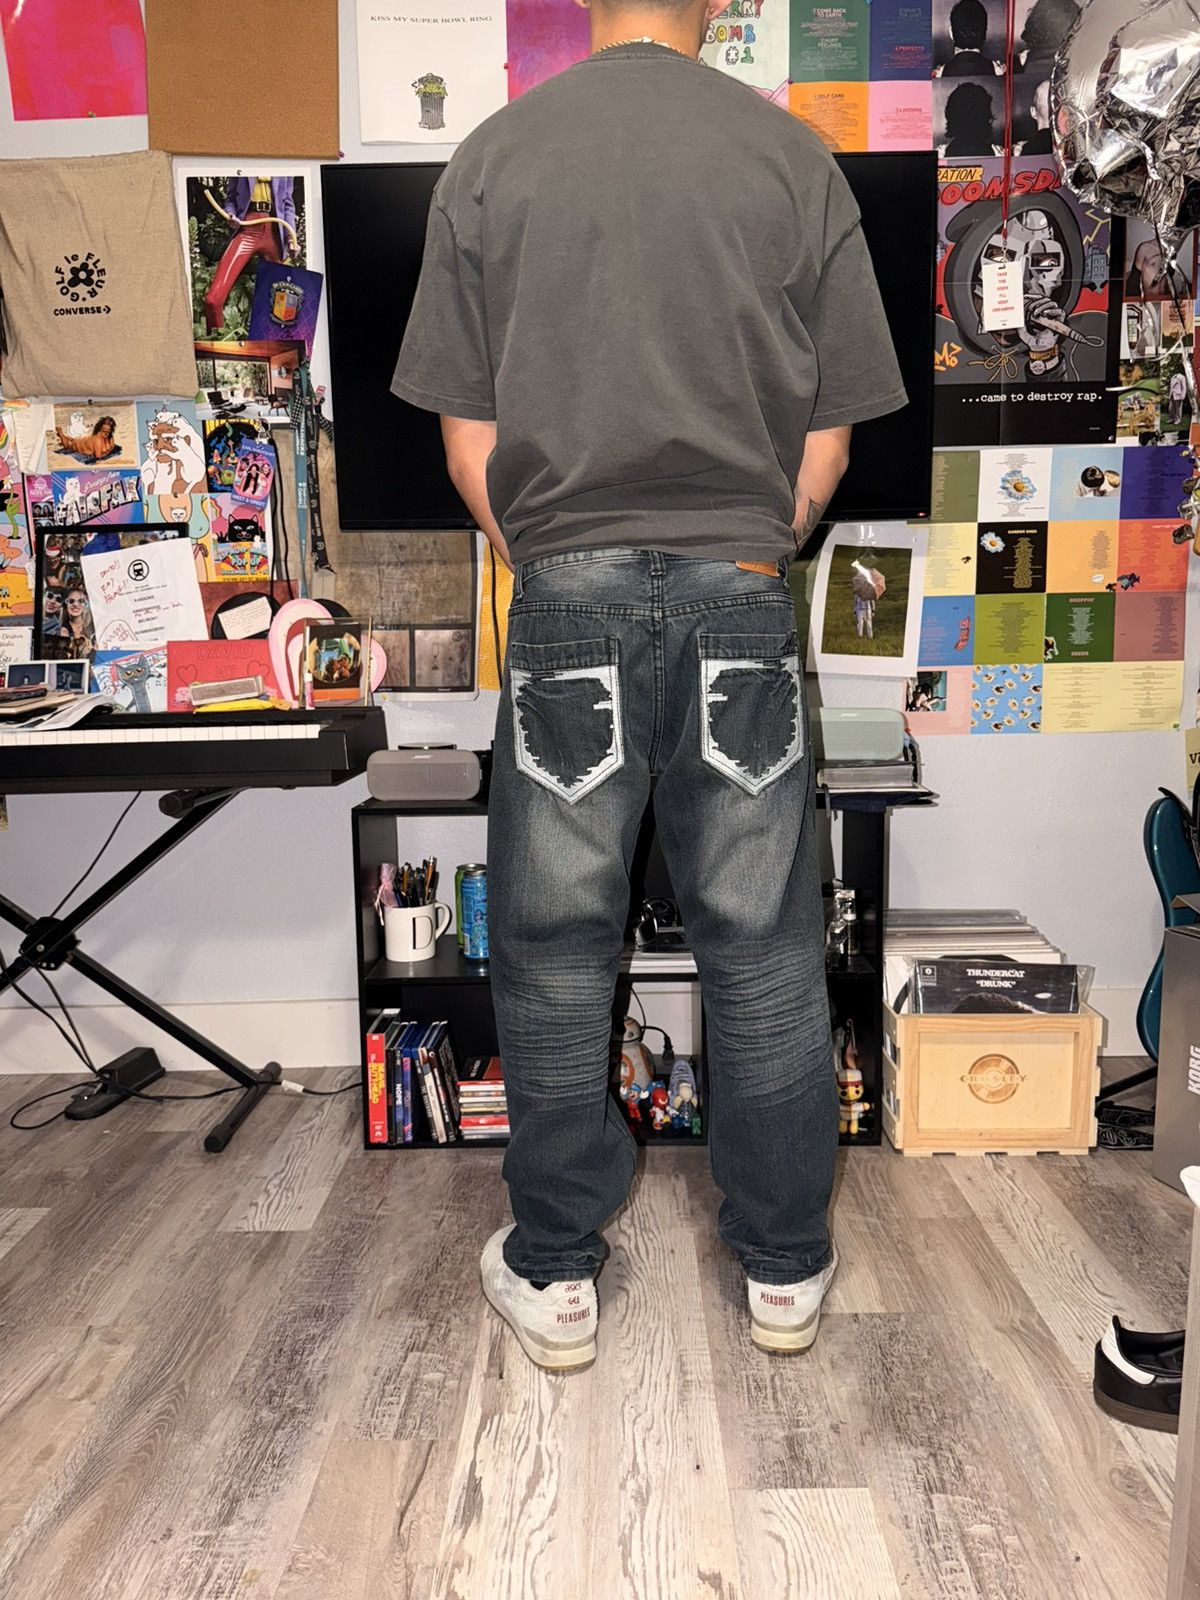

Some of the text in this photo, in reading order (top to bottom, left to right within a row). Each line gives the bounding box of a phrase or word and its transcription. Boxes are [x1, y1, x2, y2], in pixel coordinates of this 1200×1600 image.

[705, 23, 756, 44] BOMB
[725, 46, 754, 65] #1
[937, 168, 1062, 206] OOMSD
[55, 265, 80, 302] GOLF
[85, 252, 106, 298] FLEUR
[53, 306, 102, 316] CONVERSE
[1011, 393, 1024, 402] to
[1027, 391, 1074, 403] destroy
[1077, 392, 1102, 403] rap.
[197, 644, 254, 660] DAVID
[412, 915, 434, 950] D
[966, 968, 1026, 978] THUNDERCAT
[1187, 1045, 1200, 1095] KORG
[395, 1083, 403, 1106] NOPE
[760, 1291, 795, 1307] PLEASURES
[556, 1307, 591, 1324] PLEASURES
